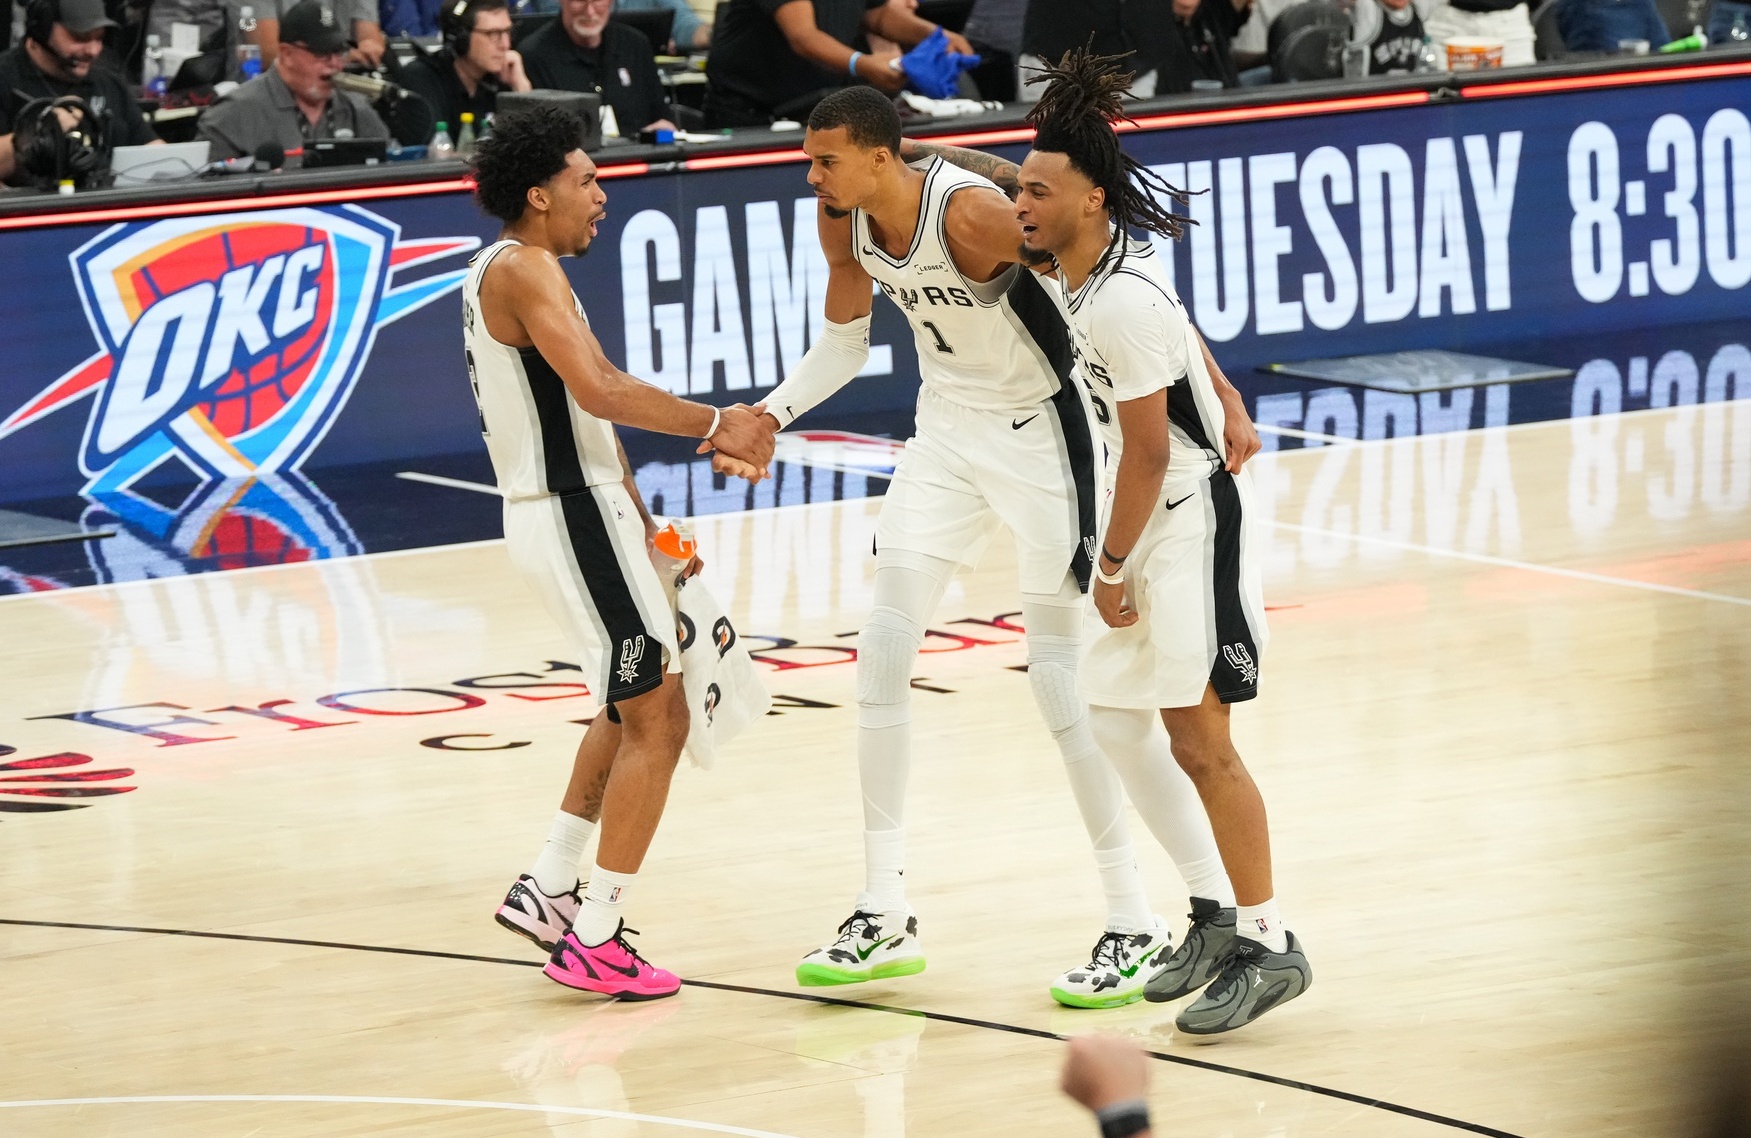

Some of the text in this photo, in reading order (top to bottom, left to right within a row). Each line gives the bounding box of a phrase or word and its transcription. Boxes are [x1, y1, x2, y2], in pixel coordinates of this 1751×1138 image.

[620, 107, 1751, 396] GAM TUESDAY 8:30
[919, 264, 944, 272] LEDGER
[97, 243, 325, 455] OKC
[920, 319, 957, 356] 1
[23, 660, 592, 748] Fros
